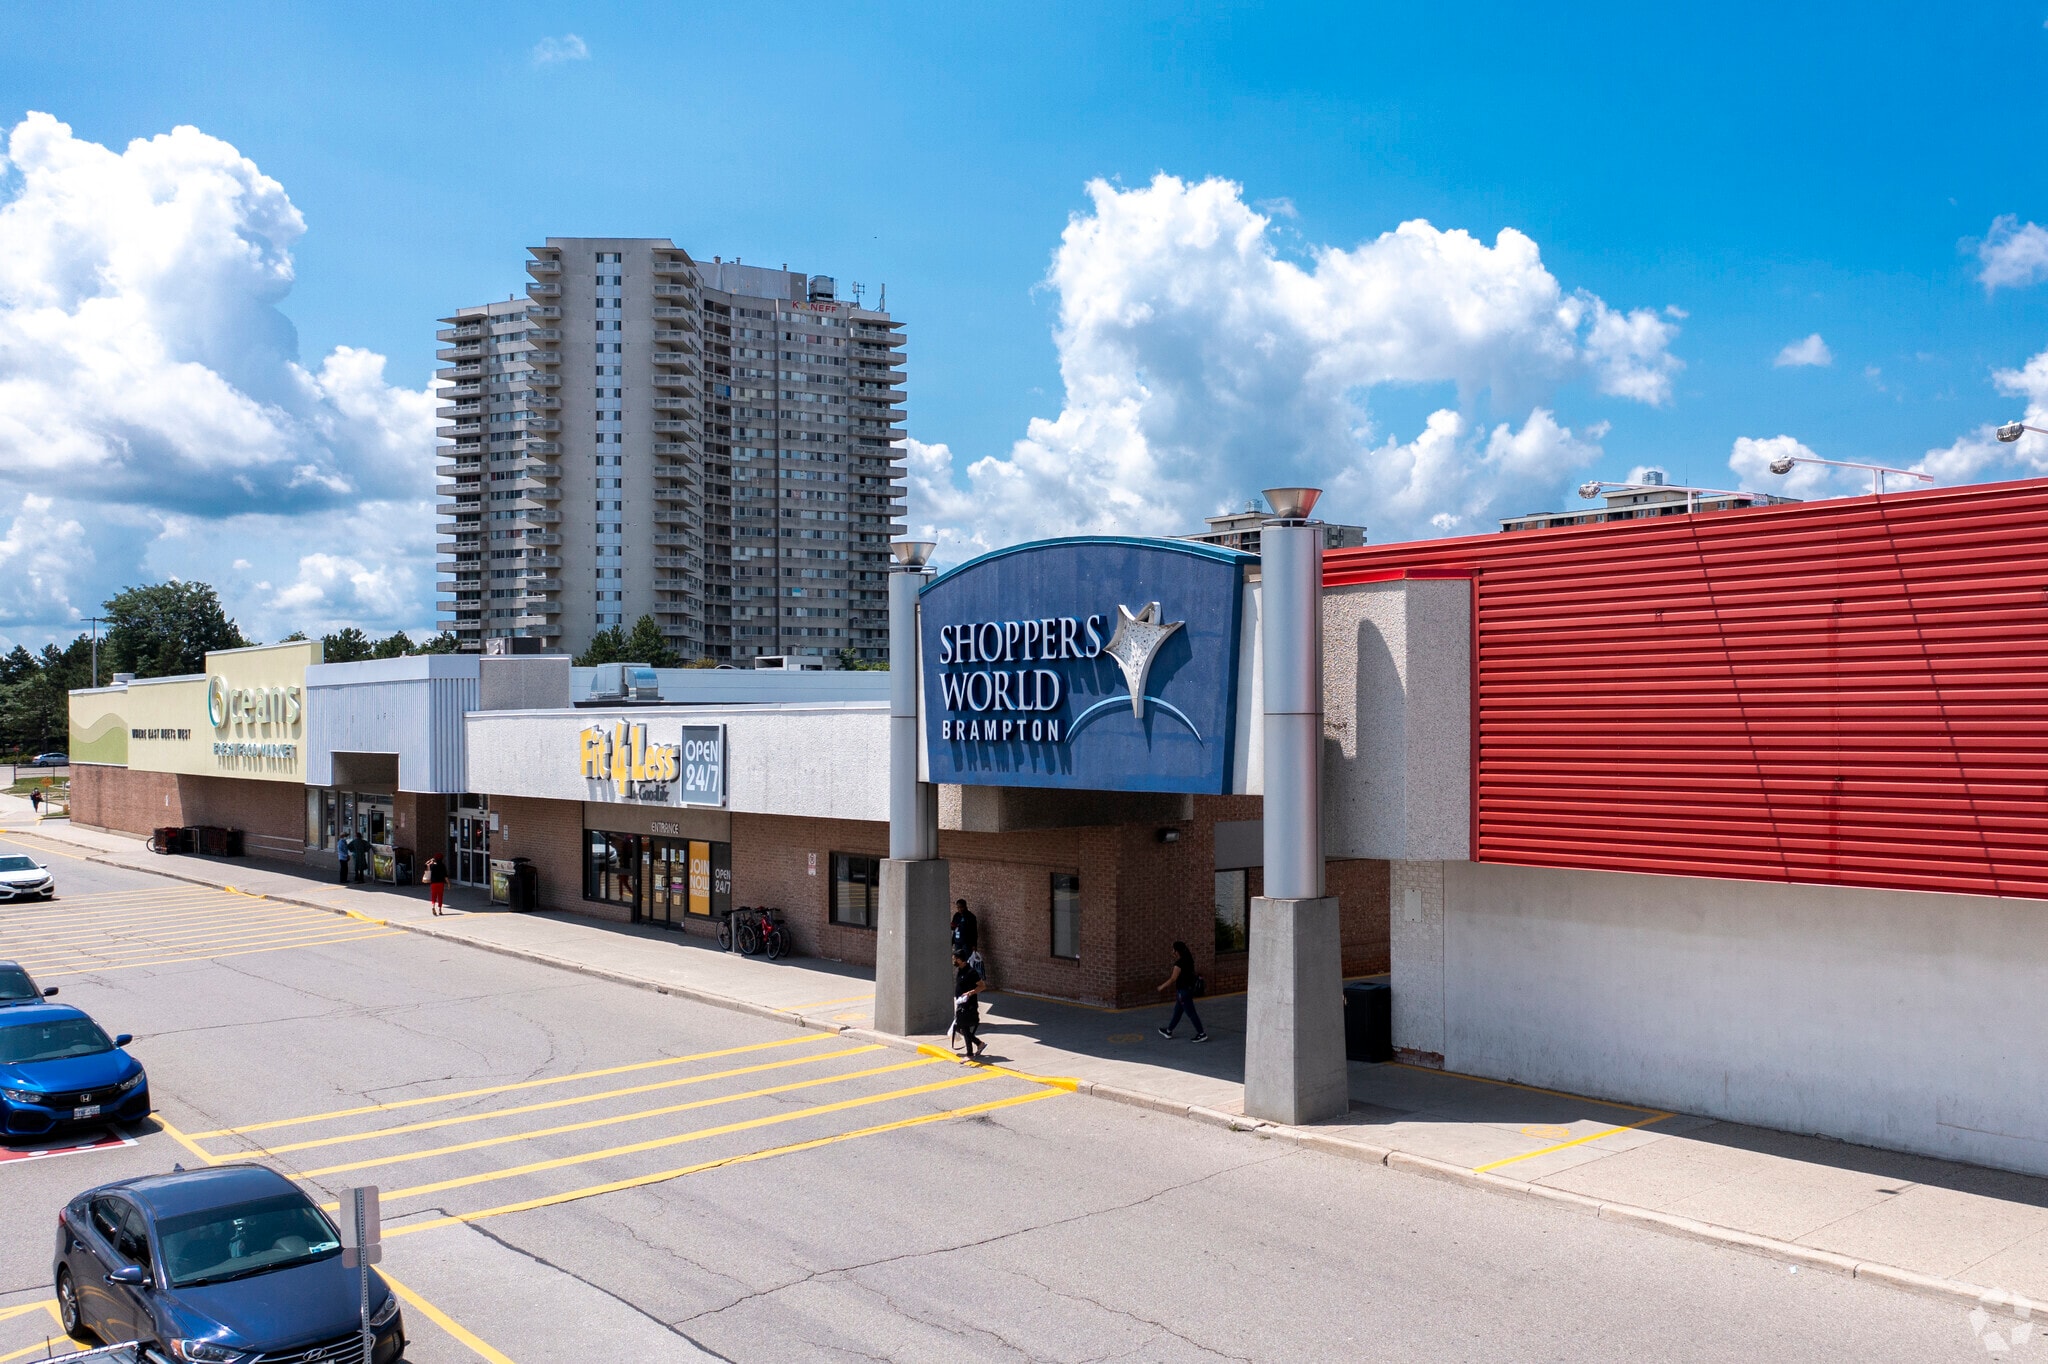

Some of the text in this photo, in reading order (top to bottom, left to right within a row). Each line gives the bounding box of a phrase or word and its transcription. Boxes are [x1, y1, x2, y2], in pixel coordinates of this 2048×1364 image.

[939, 614, 1101, 664] SHOPPERS
[939, 669, 1061, 712] WORLD
[208, 675, 301, 728] Oceans
[942, 719, 1059, 742] BRAMPTON
[213, 742, 296, 758] FRESH FOOD MARKET
[685, 739, 718, 763] OPEN
[686, 763, 719, 793] 24/7
[651, 821, 679, 835] ENTRANCE
[690, 858, 709, 875] JOIN
[715, 868, 731, 880] OPEN
[690, 875, 709, 890] NOW
[715, 880, 731, 895] 24/7
